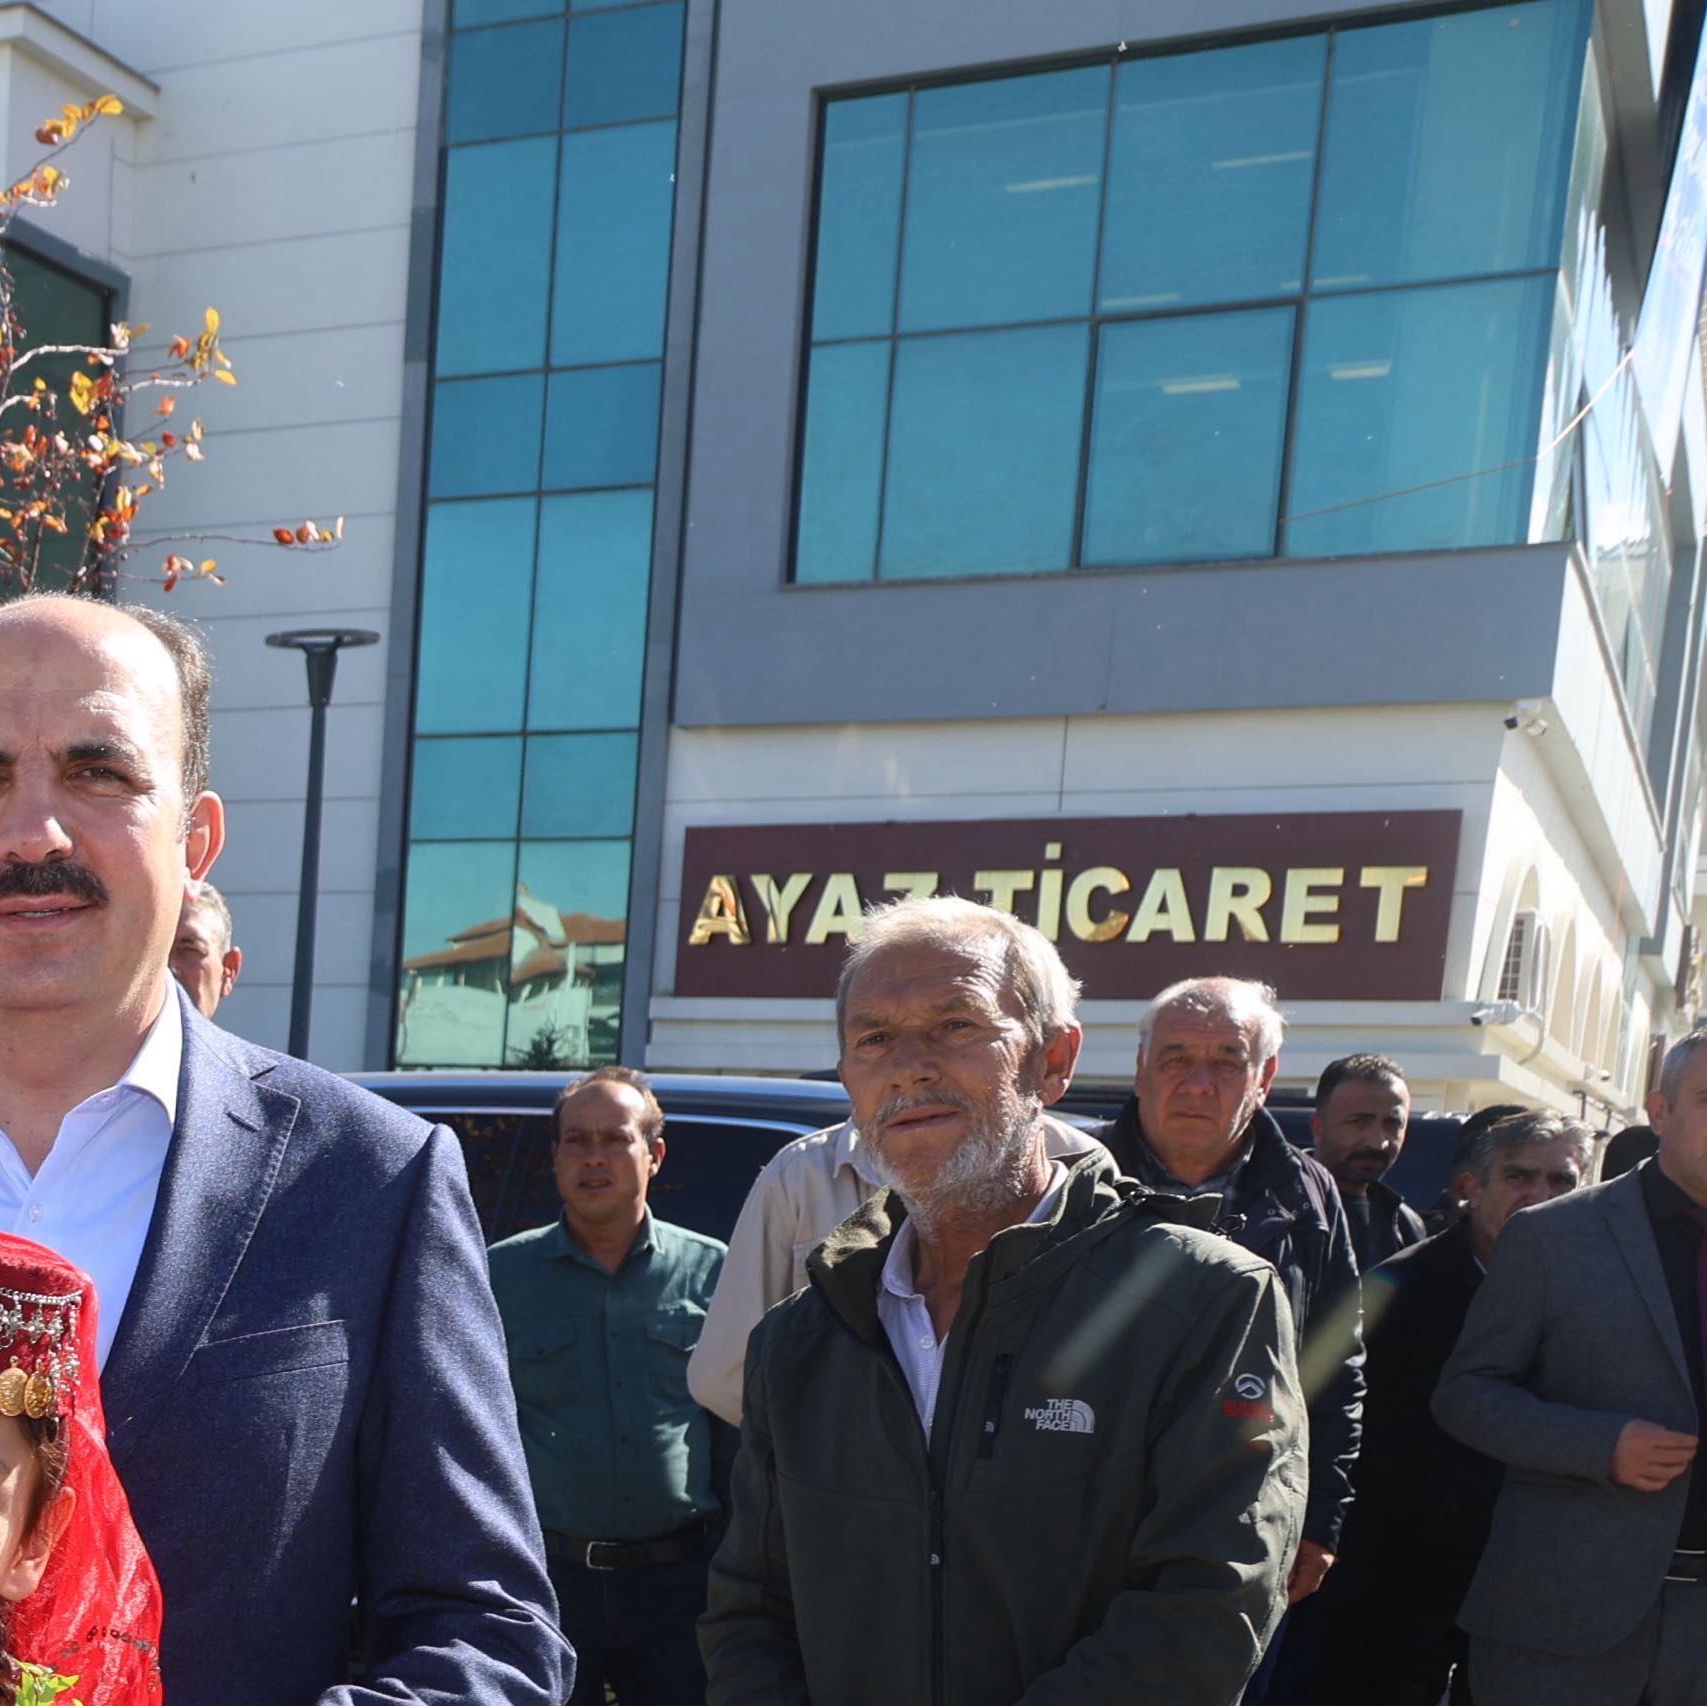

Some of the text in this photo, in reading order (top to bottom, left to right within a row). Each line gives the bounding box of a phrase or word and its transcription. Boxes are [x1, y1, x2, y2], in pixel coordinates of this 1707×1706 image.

[973, 842, 1428, 943] TİCARET
[1047, 1399, 1073, 1410] THE
[1024, 1408, 1071, 1420] NORTH
[1035, 1420, 1070, 1431] FACE
